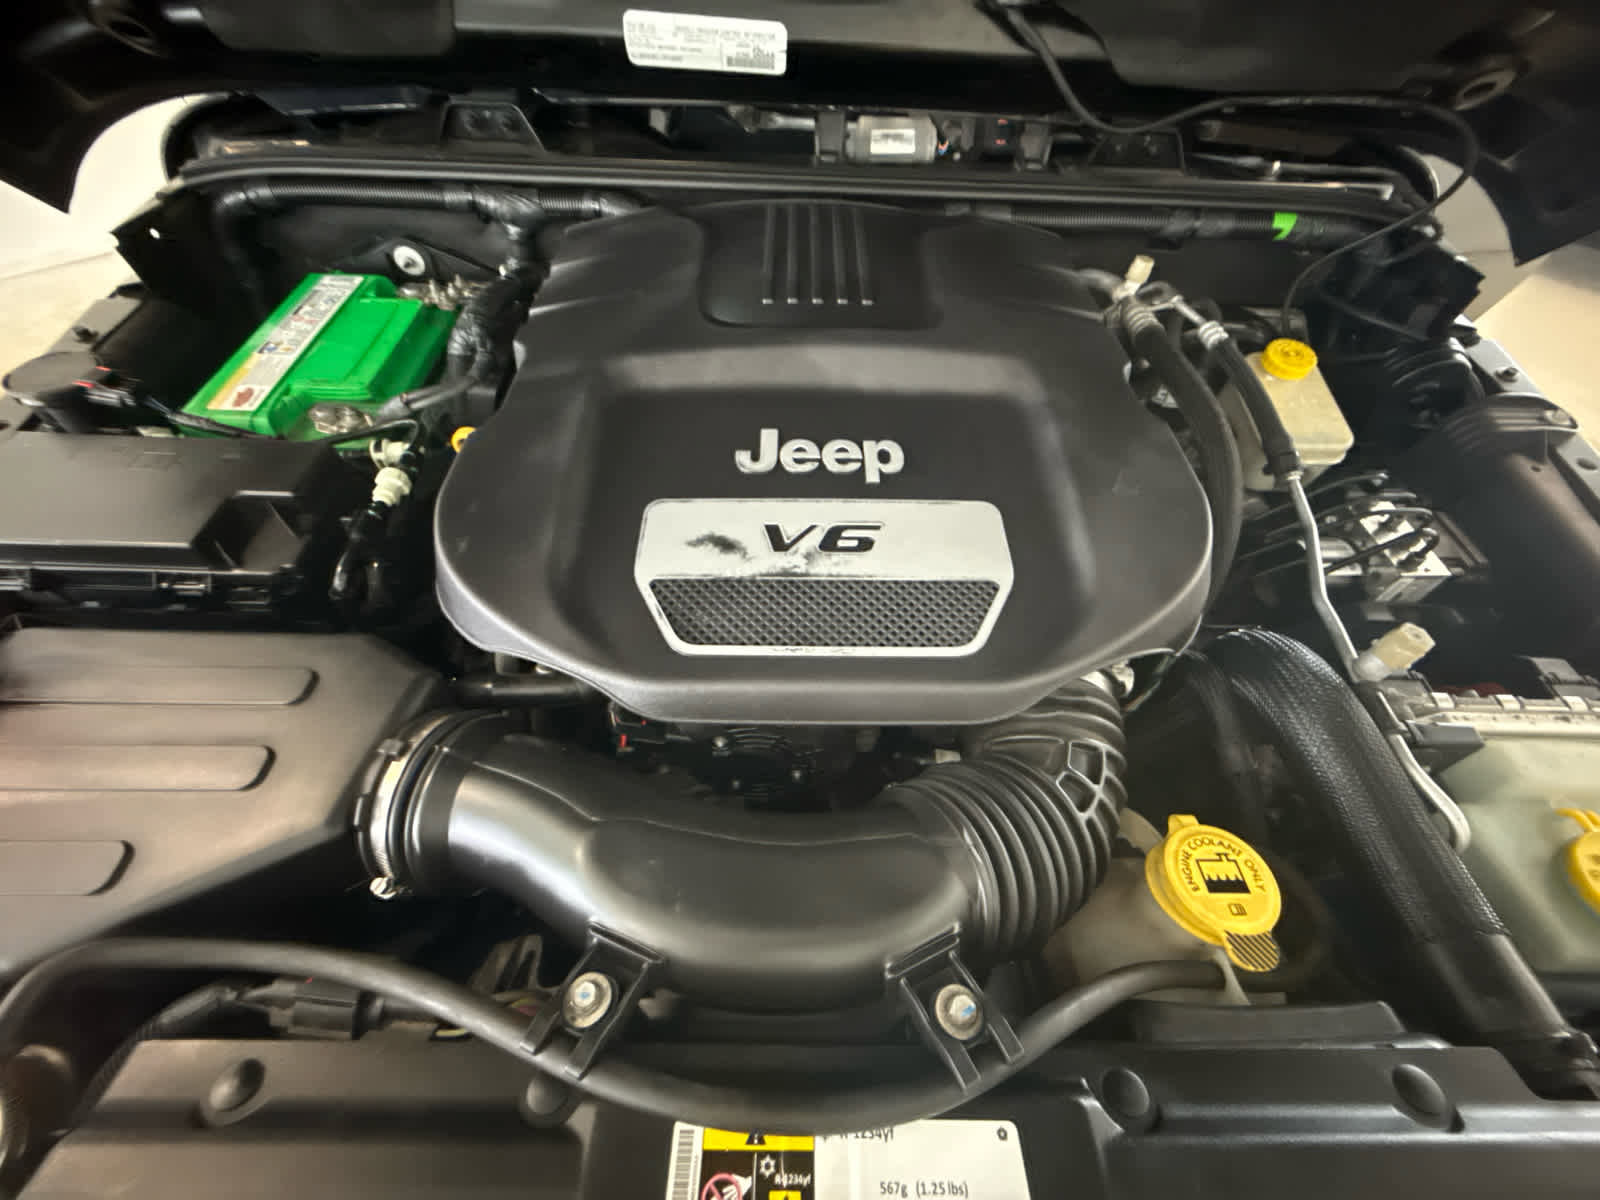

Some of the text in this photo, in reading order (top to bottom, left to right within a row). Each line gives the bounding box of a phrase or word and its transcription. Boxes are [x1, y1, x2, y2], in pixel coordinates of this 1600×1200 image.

[735, 428, 905, 484] Jeep
[763, 523, 884, 553] V6
[1182, 837, 1266, 892] ENGINE COOLANT ONLY
[880, 1181, 908, 1199] 567g
